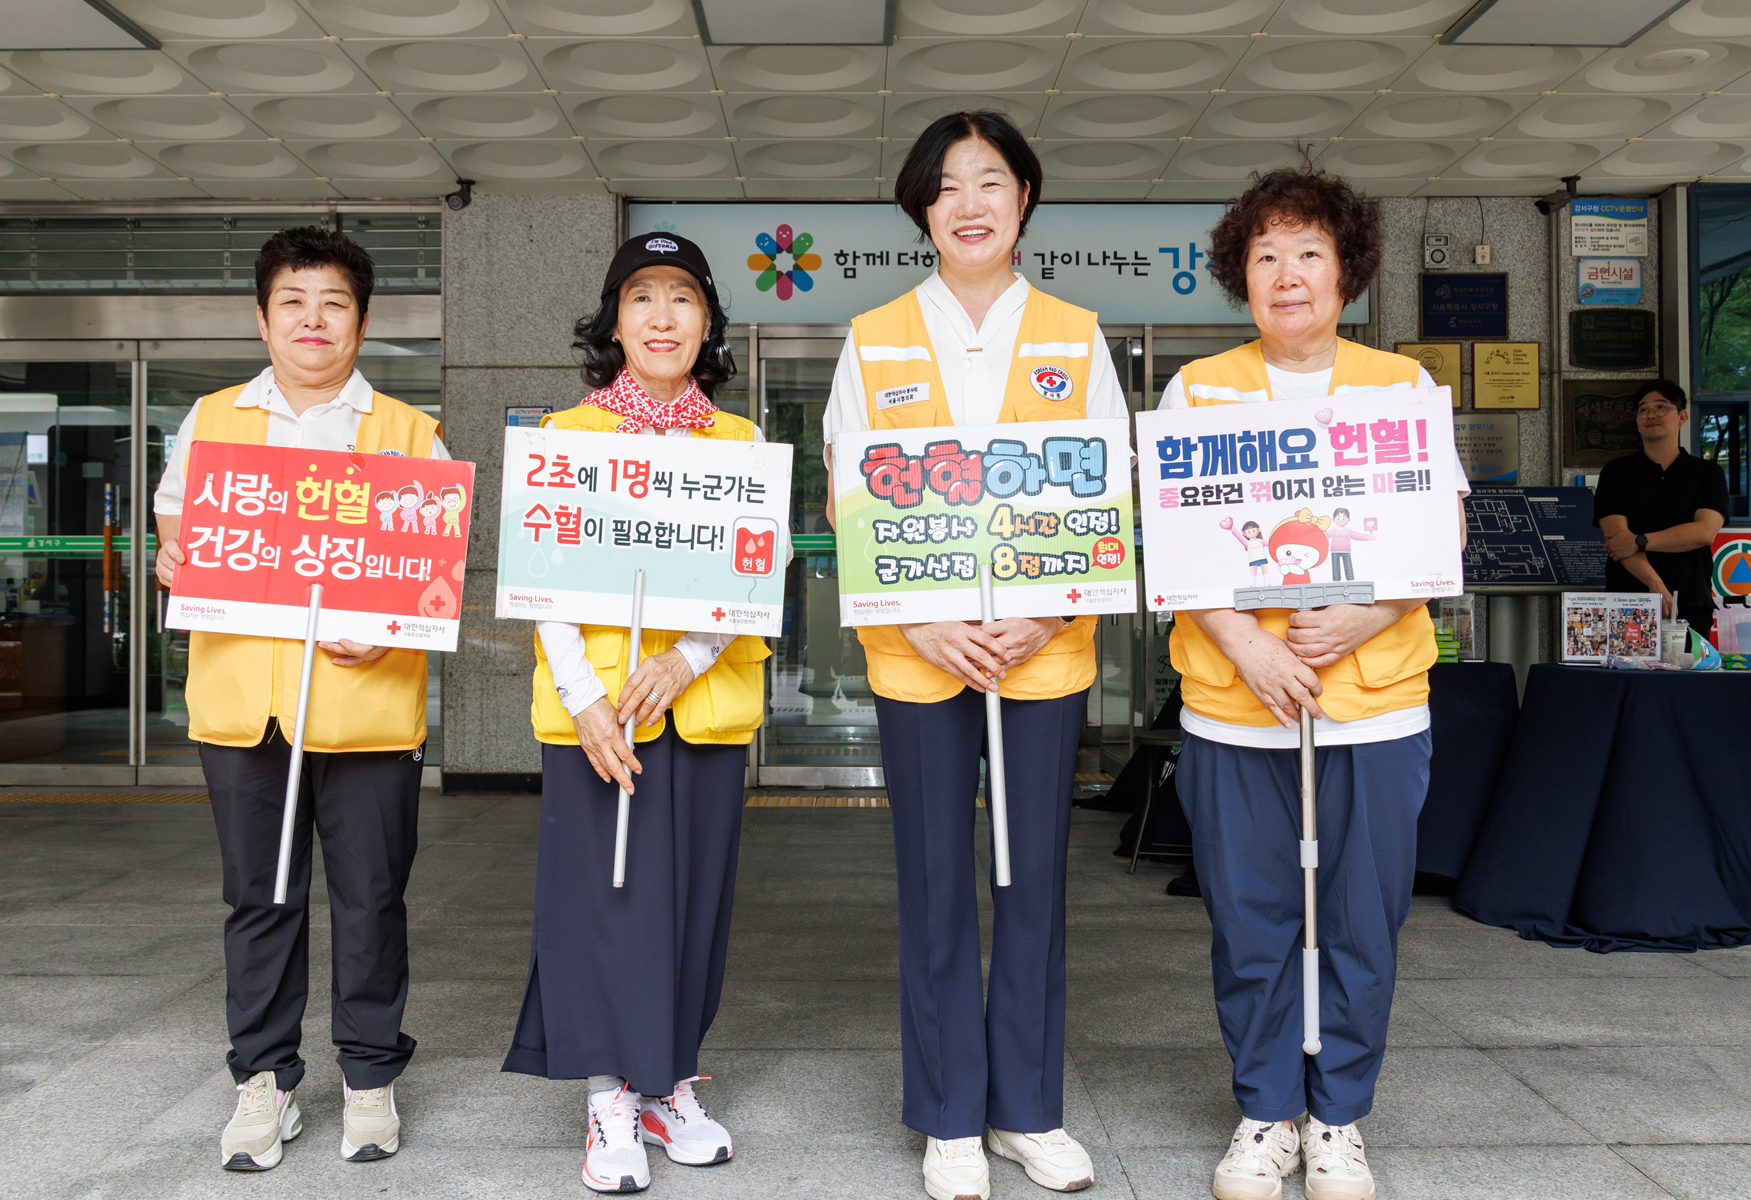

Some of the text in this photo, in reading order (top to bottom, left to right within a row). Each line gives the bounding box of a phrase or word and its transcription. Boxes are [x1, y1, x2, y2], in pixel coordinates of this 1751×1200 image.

[834, 250, 890, 279] 함께
[1034, 250, 1080, 279] 같이
[1087, 250, 1151, 277] 나누는
[1158, 242, 1211, 295] 강
[1587, 262, 1633, 280] 금연시설
[1033, 367, 1048, 376] KOREAN
[1156, 418, 1429, 480] 함께해요 헌혈!
[526, 453, 766, 504] 2초에 1명씩 누군가는
[860, 436, 1107, 509] 헌혈하면
[192, 464, 370, 525] 사랑의 헌혈
[1159, 469, 1431, 508] 중요한건 꺾이지 않는 마음!!
[523, 503, 725, 551] 수혈이 필요합니다!
[872, 503, 1121, 544] 자원봉사 4시간 인정!
[187, 526, 431, 582] 건강의 상징입니다!
[742, 557, 766, 572] 헌혈
[875, 543, 1089, 584] 군가산점 8점까지
[1096, 553, 1121, 565] 인정!
[509, 593, 554, 604] Saving Lives,
[853, 600, 878, 608] Saving
[1084, 588, 1127, 597] 대한적십자사
[180, 604, 227, 615] Saving Lives,
[729, 609, 770, 619] 대한적십자사
[404, 623, 445, 633] 대한적십자사
